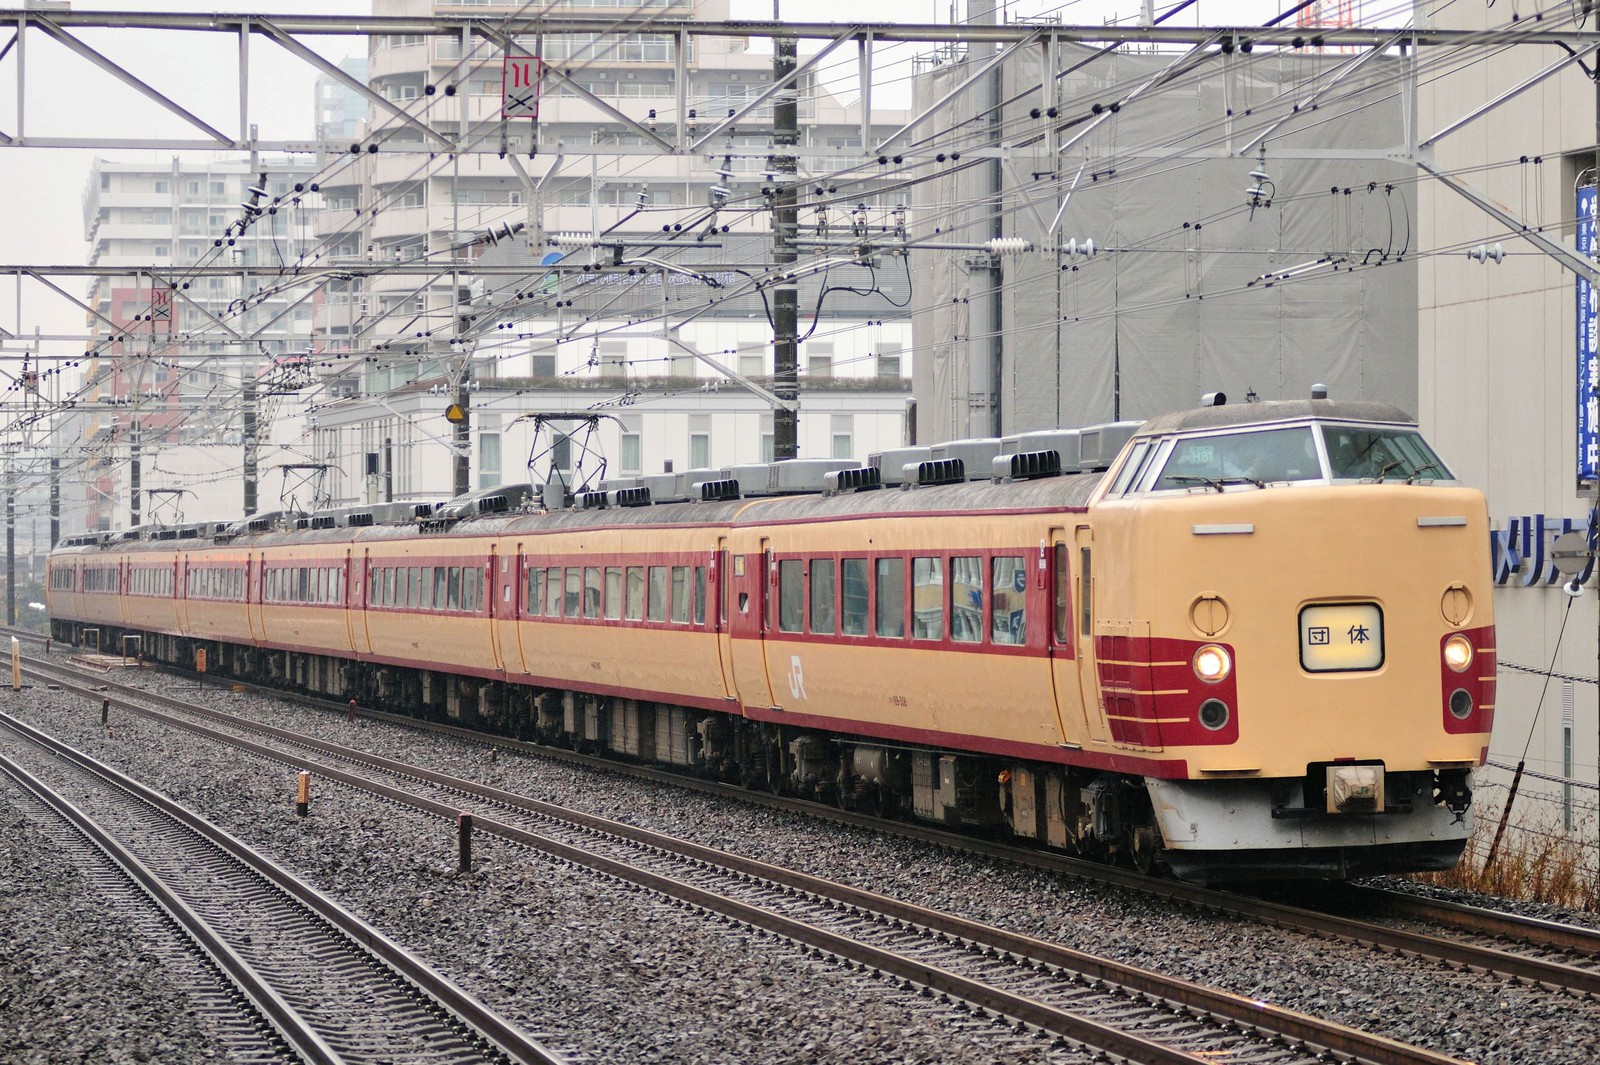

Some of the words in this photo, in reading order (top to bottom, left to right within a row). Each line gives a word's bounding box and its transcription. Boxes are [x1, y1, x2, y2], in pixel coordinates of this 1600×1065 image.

[1308, 624, 1370, 645] 団体
[788, 655, 808, 700] JR
[1356, 786, 1369, 795] JR
